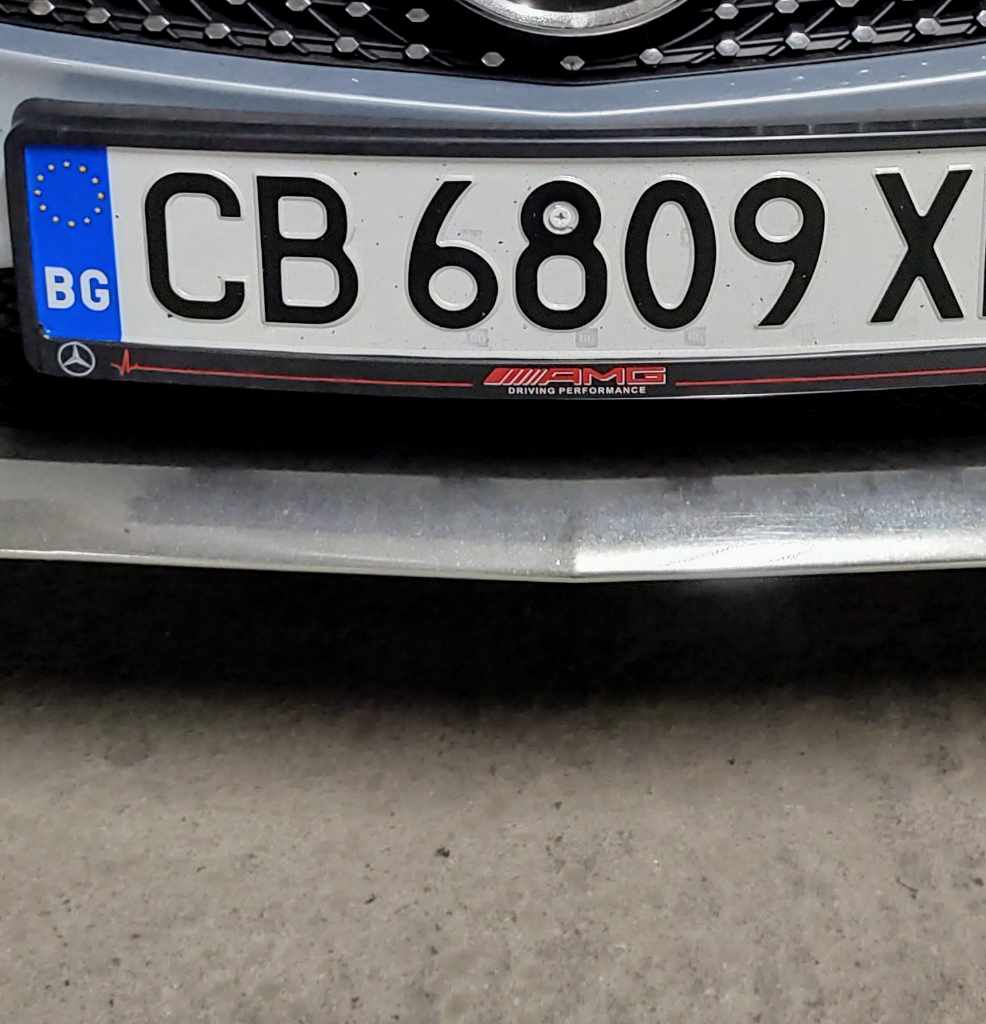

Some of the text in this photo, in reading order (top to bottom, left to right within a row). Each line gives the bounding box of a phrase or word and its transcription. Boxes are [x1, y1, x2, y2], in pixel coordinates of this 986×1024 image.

[144, 171, 359, 325] CB
[407, 176, 826, 330] 6809
[45, 267, 111, 312] BG
[508, 386, 647, 395] DRIVING PERFORMANCE
[543, 367, 666, 385] AMG
